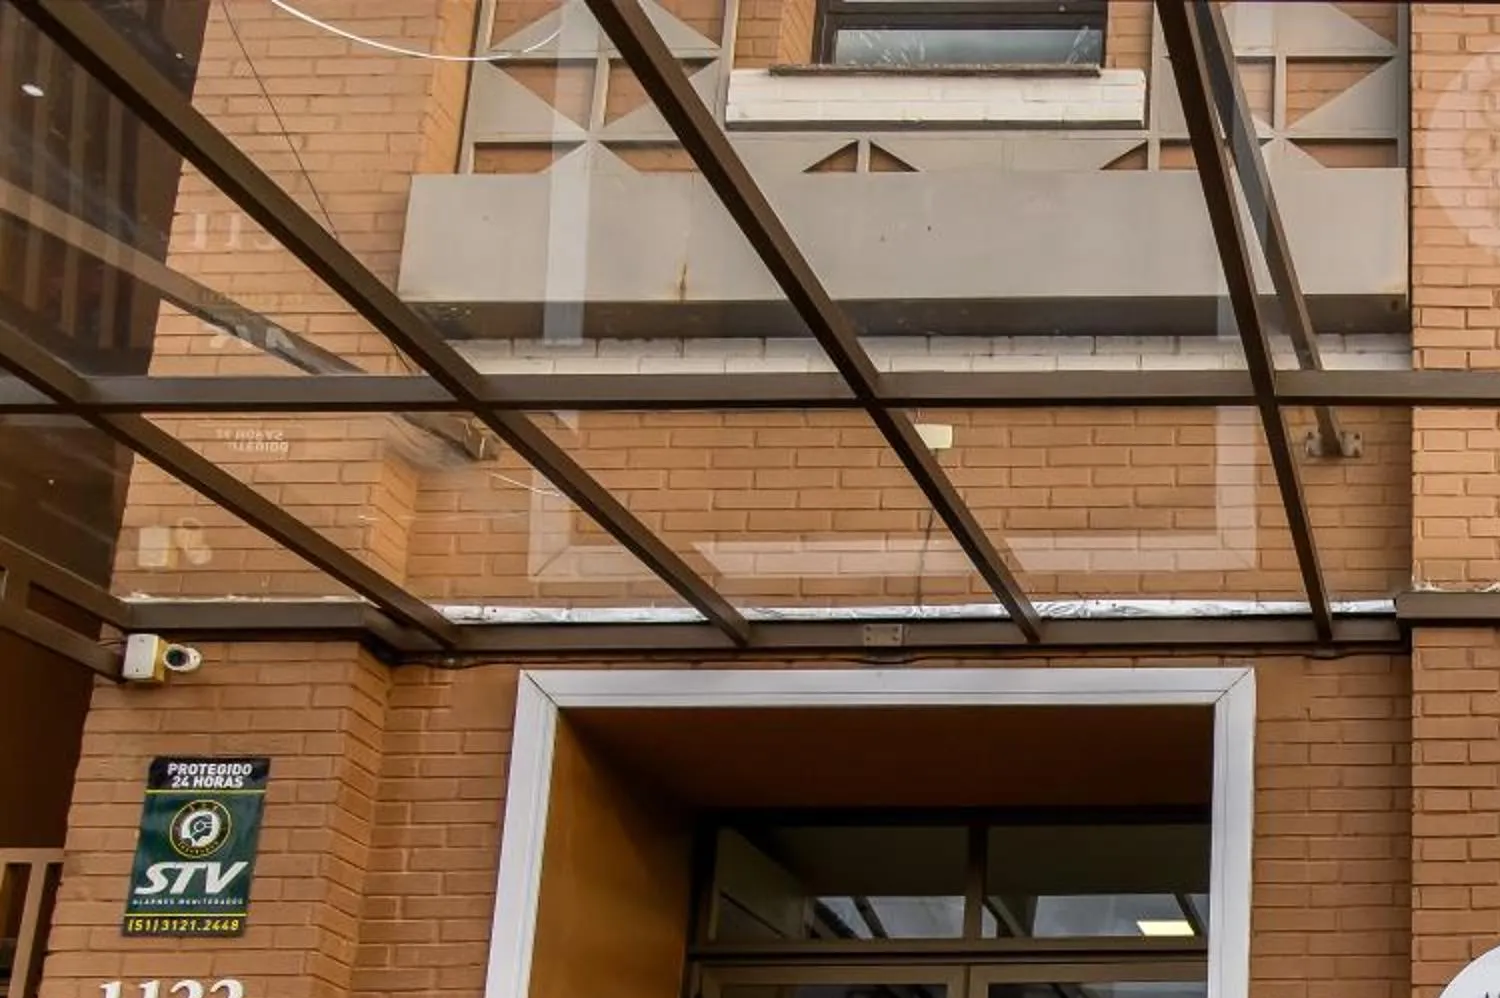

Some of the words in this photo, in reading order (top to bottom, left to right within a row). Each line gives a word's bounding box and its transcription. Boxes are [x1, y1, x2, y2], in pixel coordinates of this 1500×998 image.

[167, 763, 253, 776] PROTEGIDO
[171, 776, 190, 789] 24
[192, 776, 244, 789] HORAS
[134, 861, 249, 896] STV
